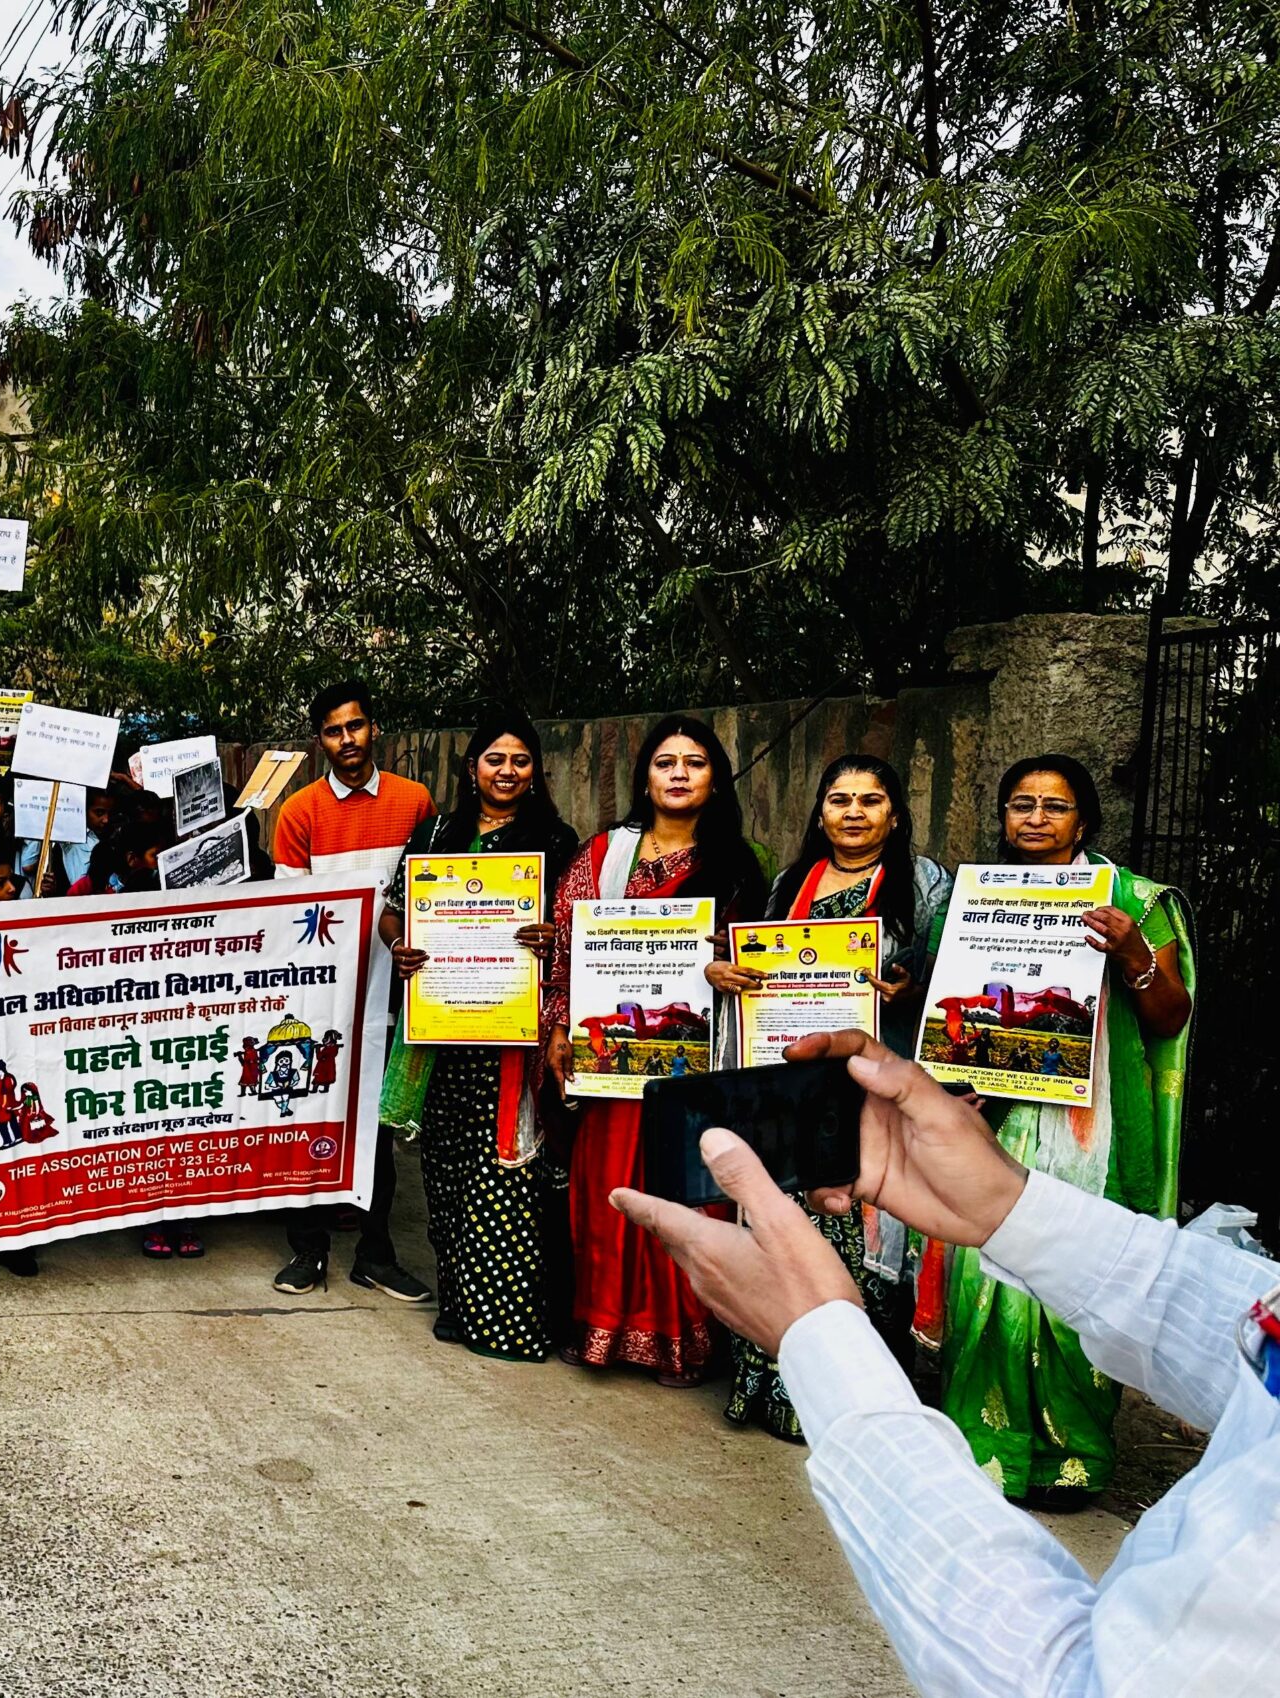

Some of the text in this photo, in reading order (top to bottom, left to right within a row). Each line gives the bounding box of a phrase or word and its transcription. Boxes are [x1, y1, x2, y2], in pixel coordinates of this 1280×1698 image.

[1020, 899, 1038, 908] विवाह
[1040, 901, 1052, 909] मुक्त
[1071, 900, 1094, 909] अभियान
[111, 914, 217, 936] राजस्थान सरकार
[962, 911, 988, 923] बाल
[991, 909, 1029, 926] विवाह
[1032, 914, 1059, 930] मुक्त
[585, 938, 698, 954] बाल विवाह मुक्त भारत
[649, 929, 660, 937] मुक्त
[57, 928, 265, 970] जिला बाल संरक्षण इकाई
[34, 978, 160, 1012] अधिकारिता
[29, 1021, 57, 1036] बाल
[59, 1016, 96, 1033] विवाह
[98, 1012, 138, 1031] कानून
[140, 1006, 185, 1025] अपराध
[186, 1002, 196, 1019] है
[198, 1002, 235, 1021] कृपया
[260, 994, 290, 1012] रोकें
[64, 1024, 231, 1074] पहले पढ़ाई
[947, 1066, 993, 1076] ASSOCIATION
[1020, 1074, 1039, 1082] CLUB
[64, 1087, 126, 1123] फिर
[82, 1126, 110, 1139] बाल
[113, 1120, 160, 1135] संरक्षण
[161, 1117, 186, 1132] मूल
[8, 1130, 310, 1181] THE ASSOCIATION OF WE CLUB OF INDIA
[87, 1153, 228, 1179] WE DISTRICT 323 E-2
[62, 1184, 84, 1197] WE
[87, 1178, 126, 1192] CLUB
[129, 1171, 173, 1186] JASOL
[185, 1162, 253, 1179] BALOTRA
